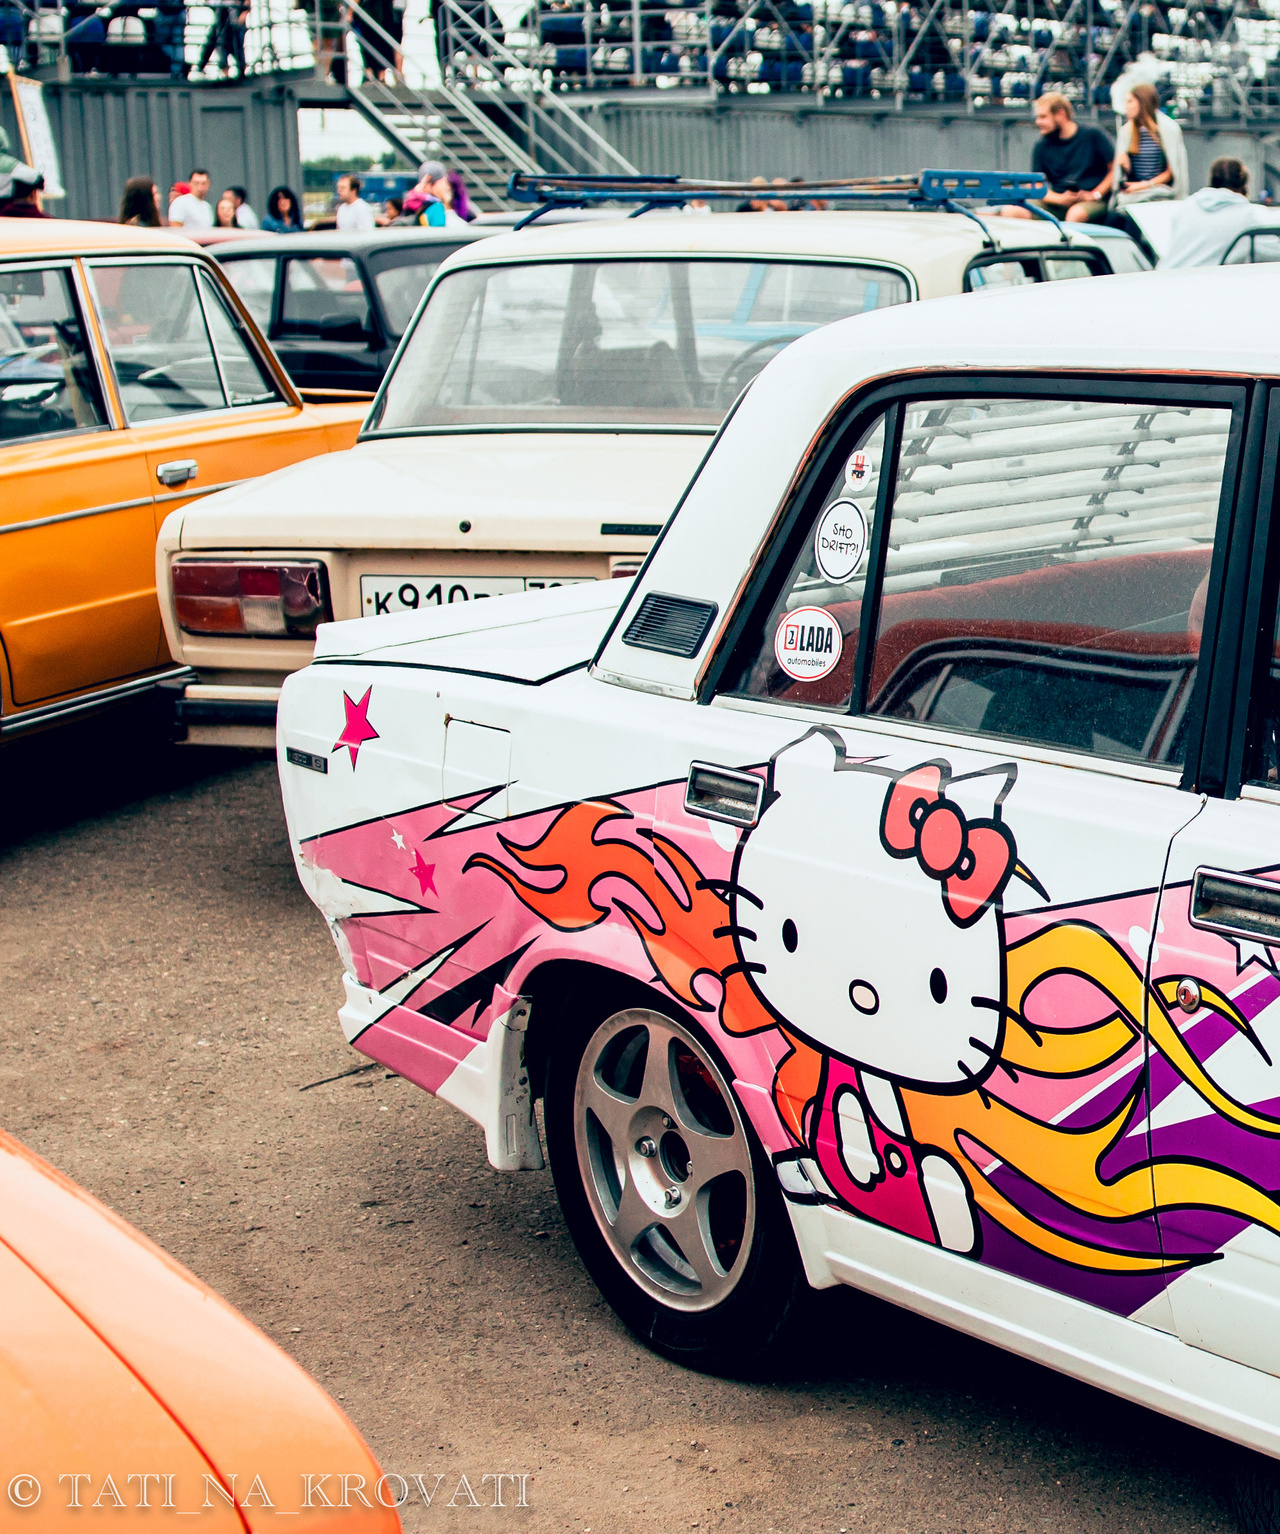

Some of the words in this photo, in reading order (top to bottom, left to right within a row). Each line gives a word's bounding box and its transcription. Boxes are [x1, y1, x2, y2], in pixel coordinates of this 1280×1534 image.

[832, 523, 853, 539] SHO
[821, 537, 859, 558] DRIFT?!
[799, 625, 833, 653] LADA
[786, 656, 826, 668] automobiles
